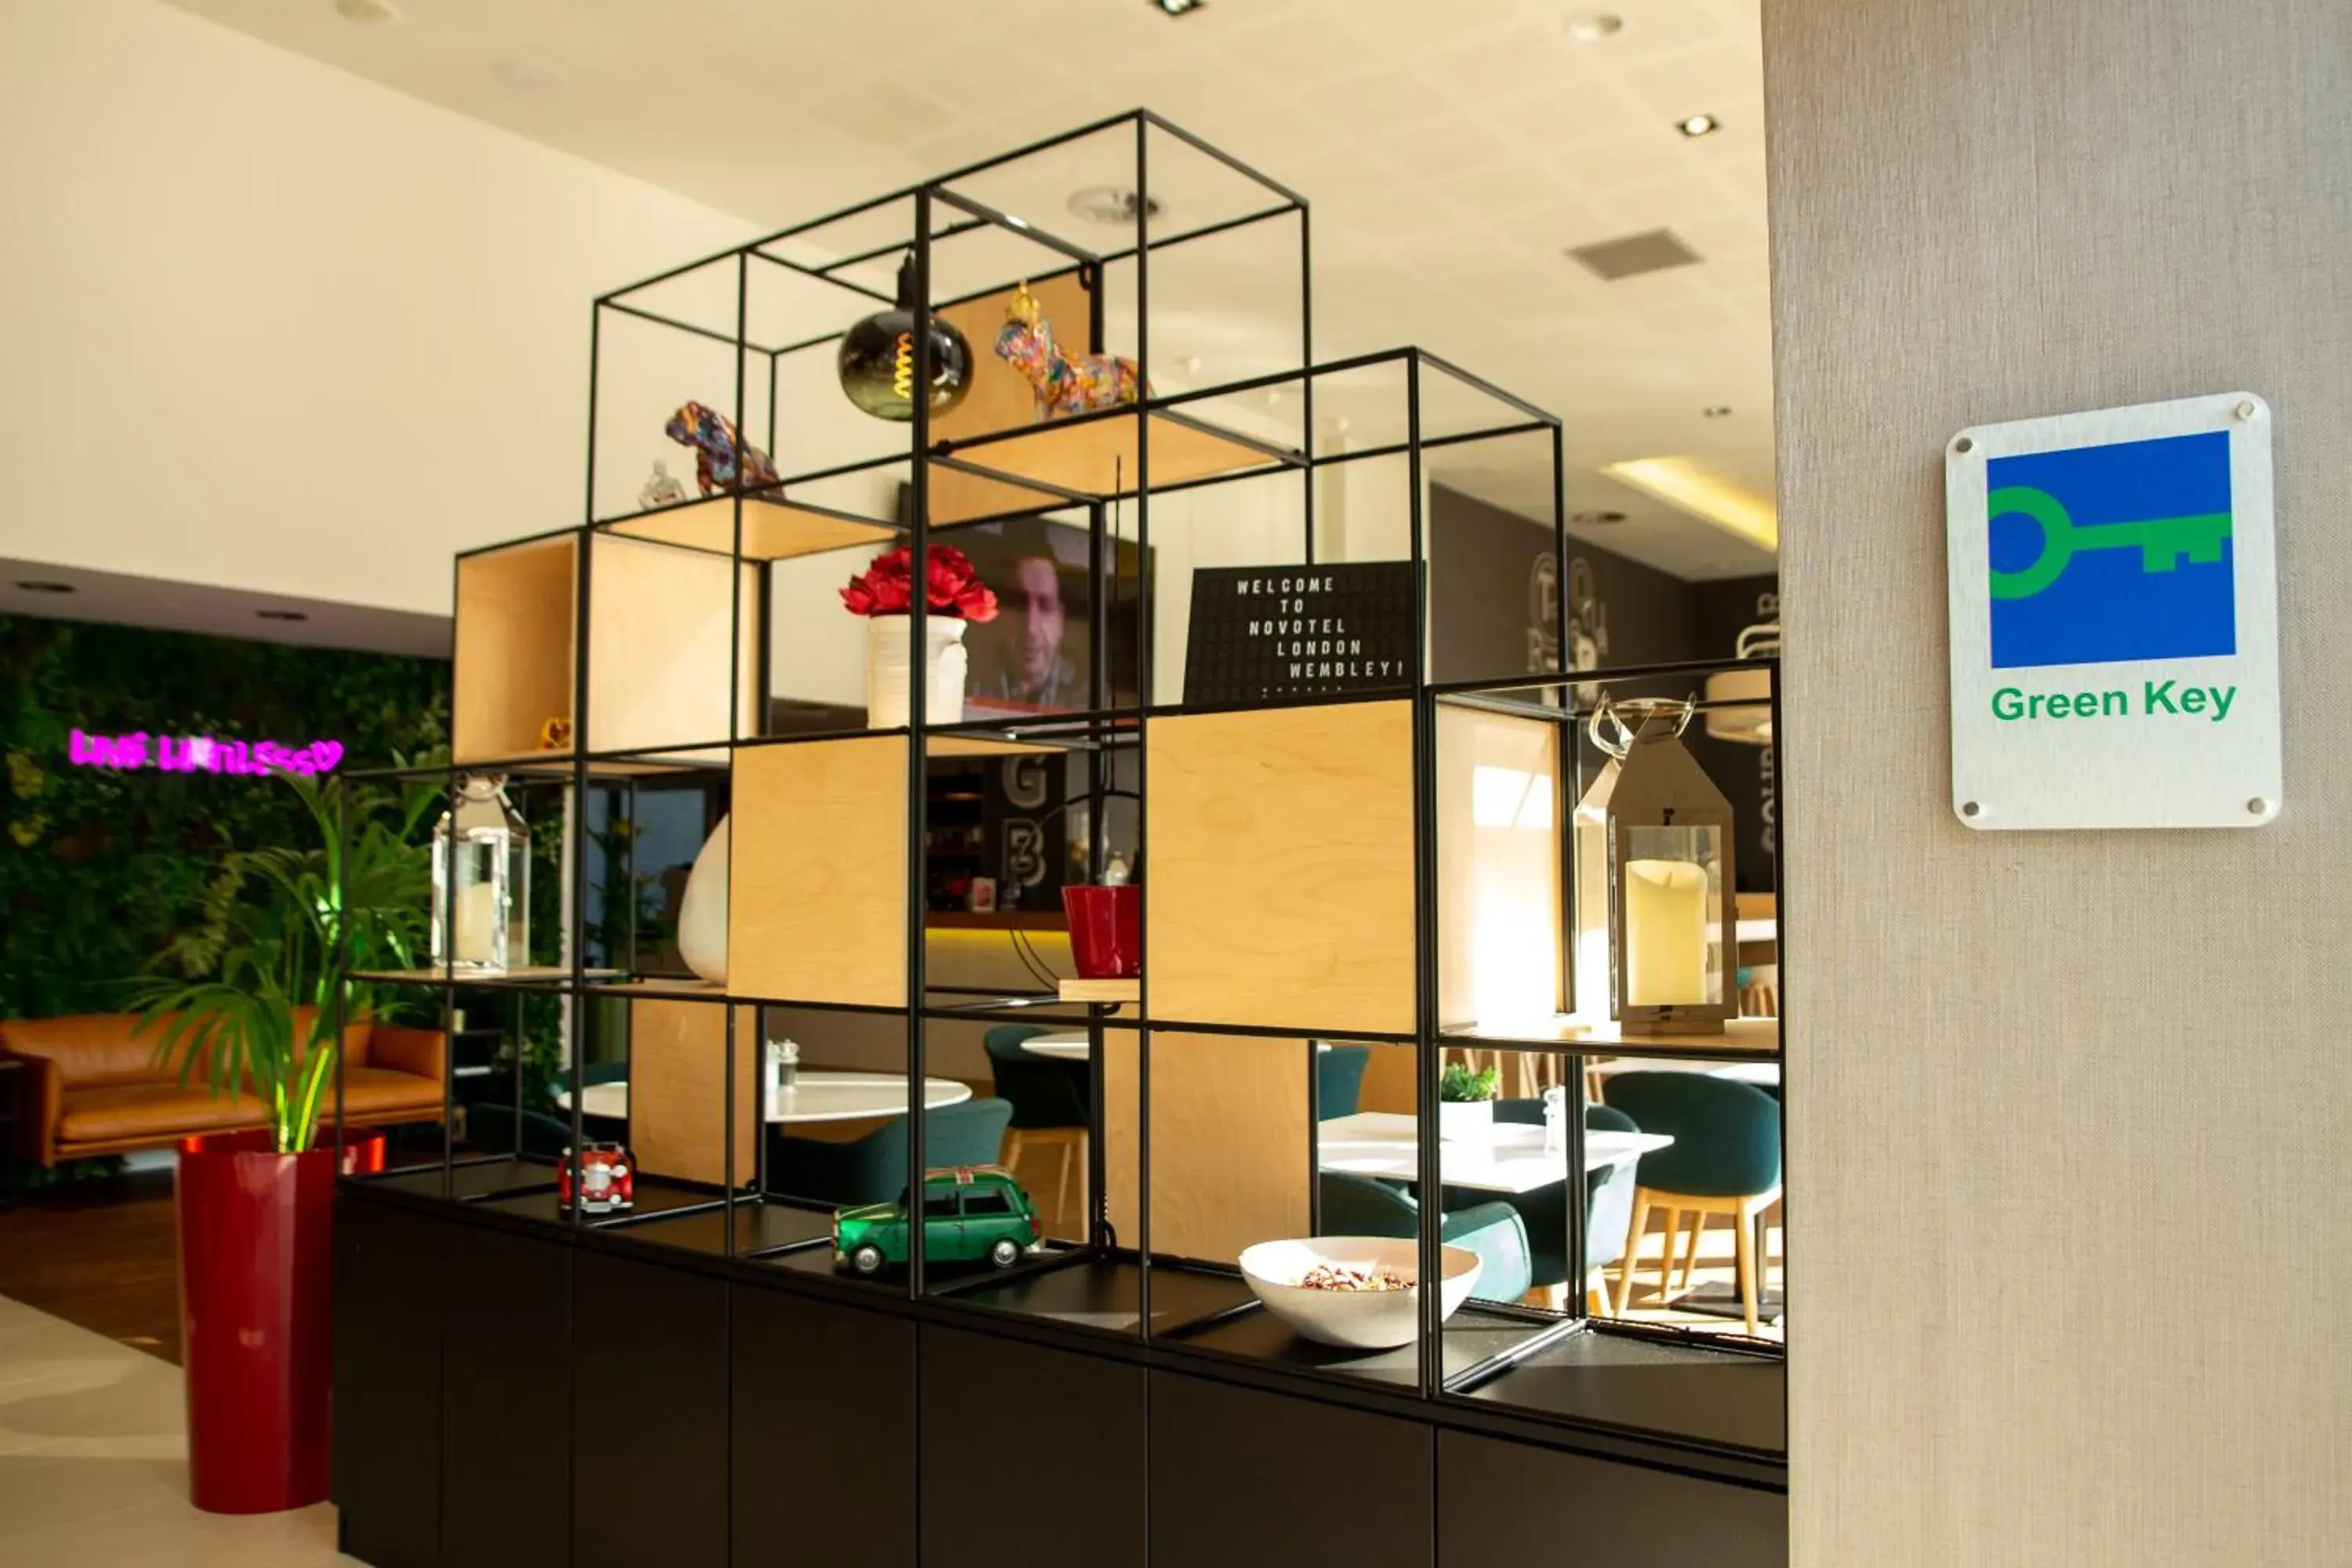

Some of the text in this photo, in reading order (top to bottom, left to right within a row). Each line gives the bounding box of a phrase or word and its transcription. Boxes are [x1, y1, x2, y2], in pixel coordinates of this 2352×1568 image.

[1237, 577, 1333, 595] WELCOME
[1280, 598, 1304, 614] TO
[1249, 619, 1345, 636] NOVOTEL
[1276, 639, 1361, 657] LONDON
[1991, 680, 2237, 722] Green Key
